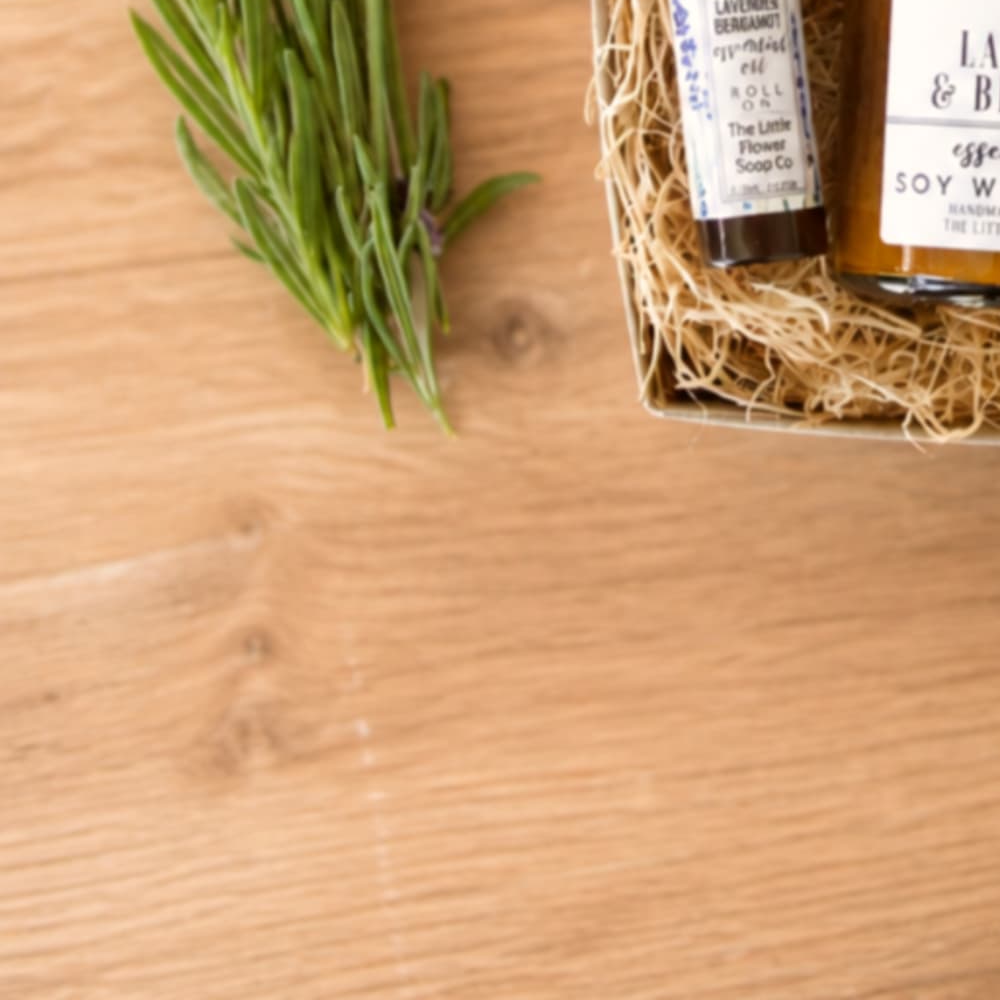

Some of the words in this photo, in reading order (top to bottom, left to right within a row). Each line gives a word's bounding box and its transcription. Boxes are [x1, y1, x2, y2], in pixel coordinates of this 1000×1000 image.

[714, 13, 781, 35] BERGAMOT
[931, 72, 956, 109] &
[728, 120, 755, 137] The
[757, 117, 792, 135] Little
[739, 136, 786, 155] Flower
[736, 156, 774, 174] Soap
[775, 153, 793, 170] Co
[895, 171, 952, 196] SOY
[944, 218, 967, 234] THE
